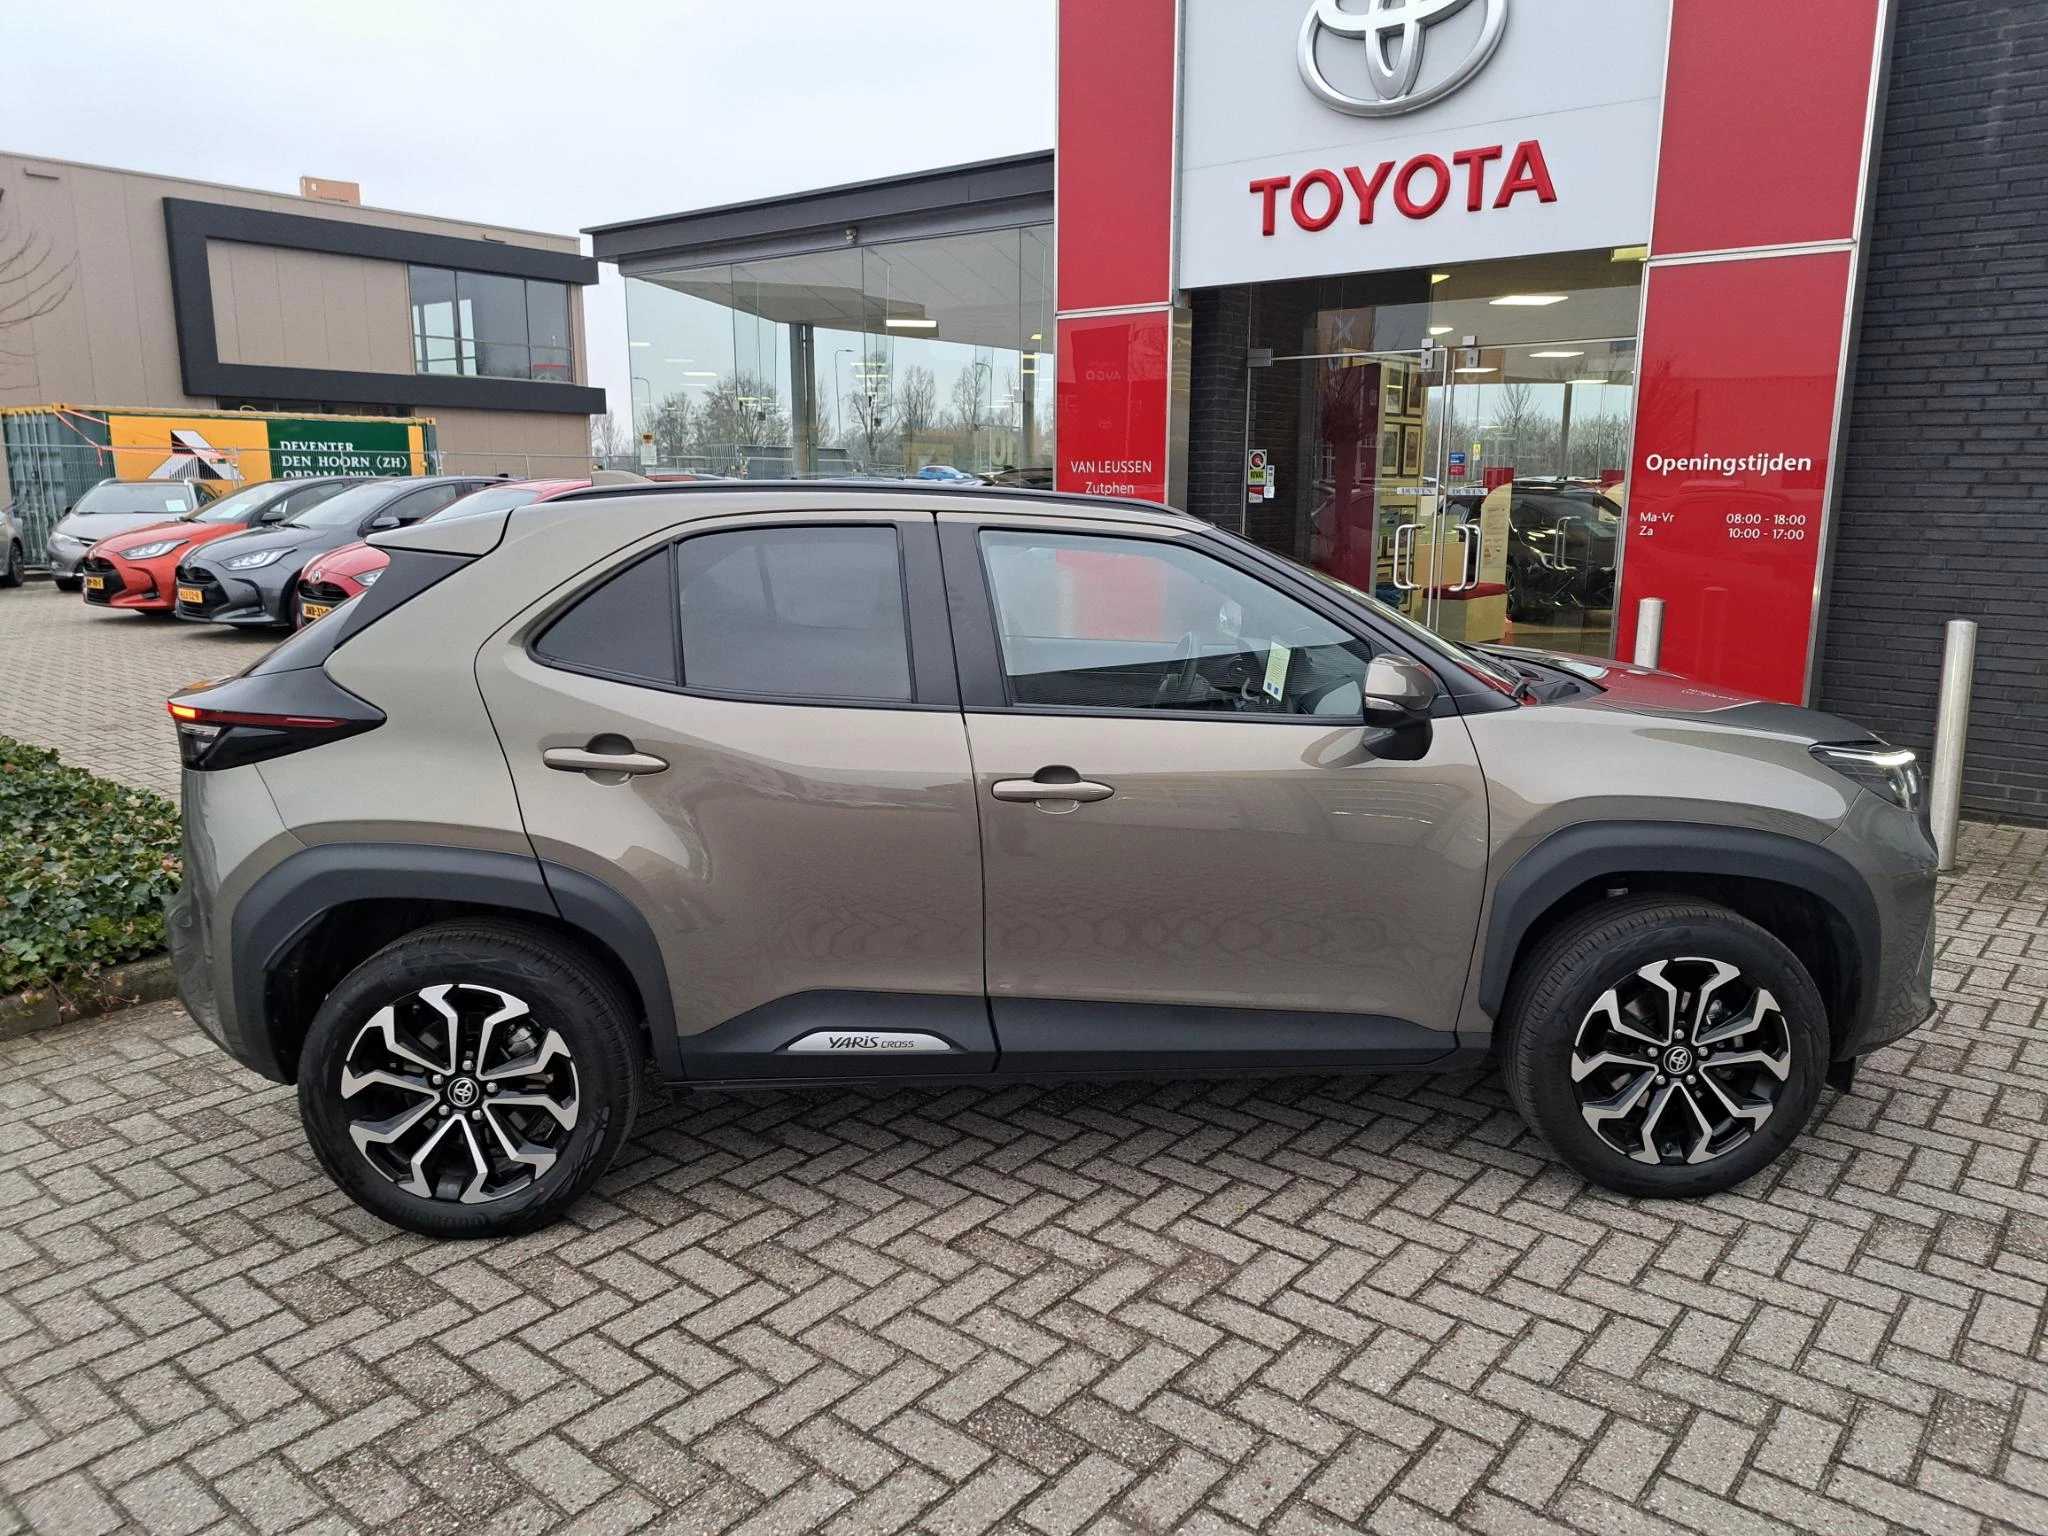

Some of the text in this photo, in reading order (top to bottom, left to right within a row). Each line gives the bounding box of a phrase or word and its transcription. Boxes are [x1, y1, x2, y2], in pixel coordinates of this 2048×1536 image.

[1250, 139, 1557, 236] TOYOTA
[280, 441, 354, 452] DEVENTER
[281, 455, 407, 469] DEN HOORN (ZH)
[1070, 461, 1152, 473] VAN LEUSSEN
[1646, 453, 1811, 476] Openingstijden
[1085, 481, 1135, 496] Zutphen
[1639, 512, 1675, 522] Ma-Vr
[1726, 513, 1762, 525] 08:00
[1773, 514, 1806, 526] 18:00
[1638, 526, 1653, 536] Za
[1728, 528, 1760, 539] 10:00
[1772, 529, 1805, 540] 17:00
[881, 1040, 914, 1049] CROSS
